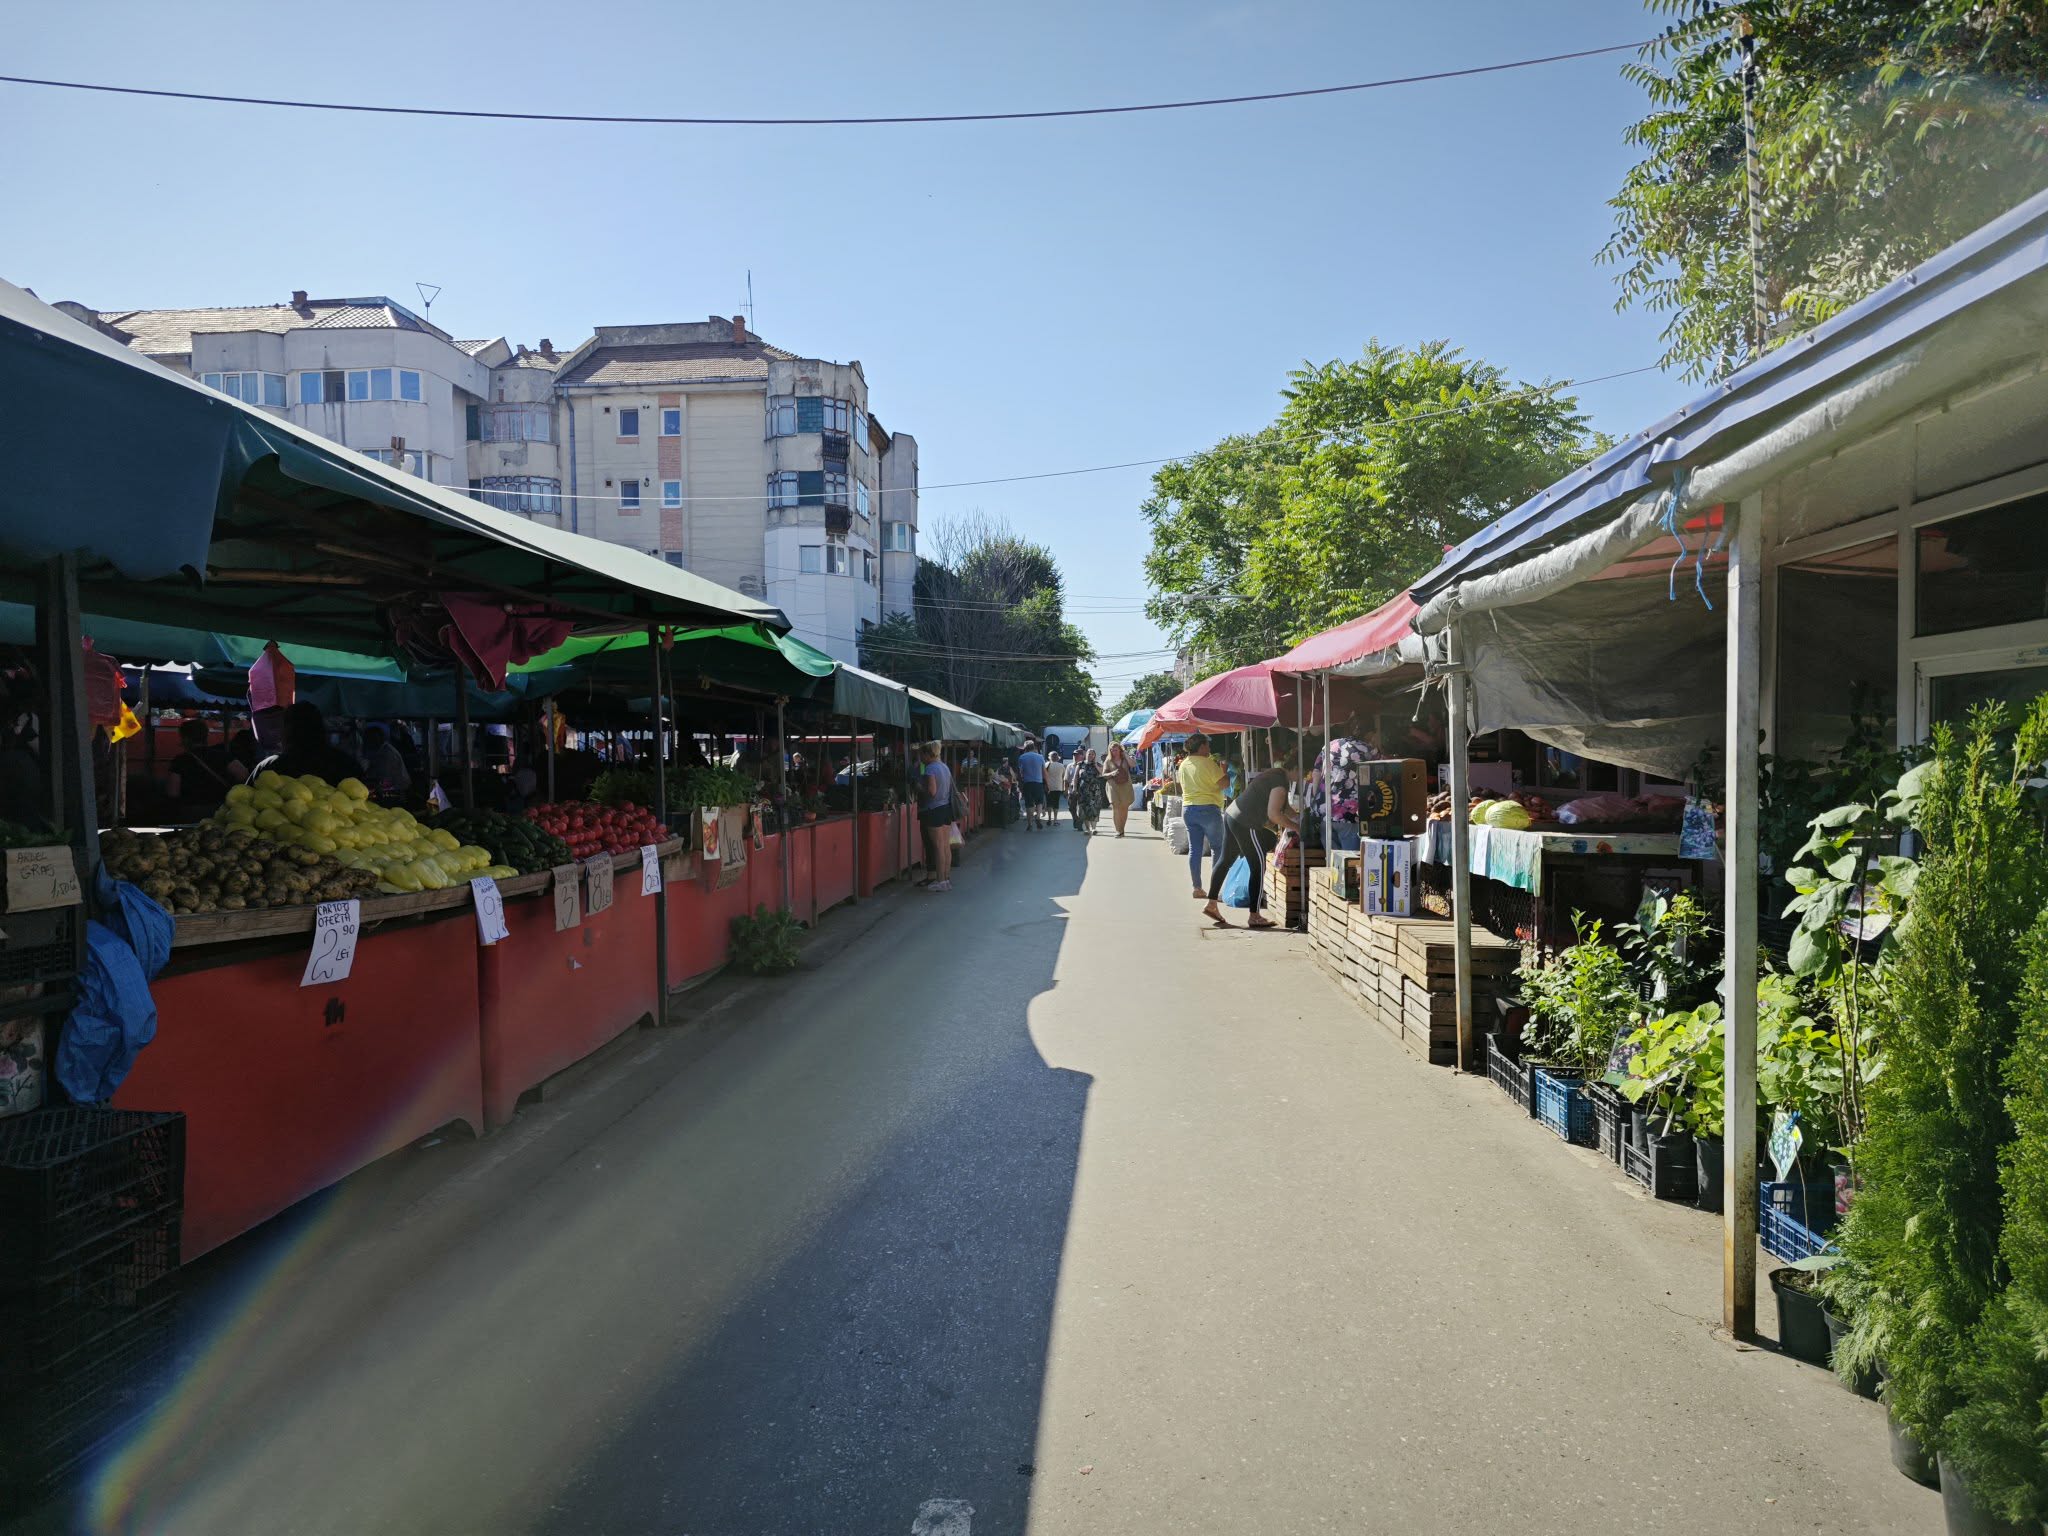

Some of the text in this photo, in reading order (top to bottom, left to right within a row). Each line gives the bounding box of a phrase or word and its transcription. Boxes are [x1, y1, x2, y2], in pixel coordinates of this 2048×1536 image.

[317, 913, 352, 928] OFERTA
[311, 928, 338, 981] 2
[342, 924, 356, 936] 90
